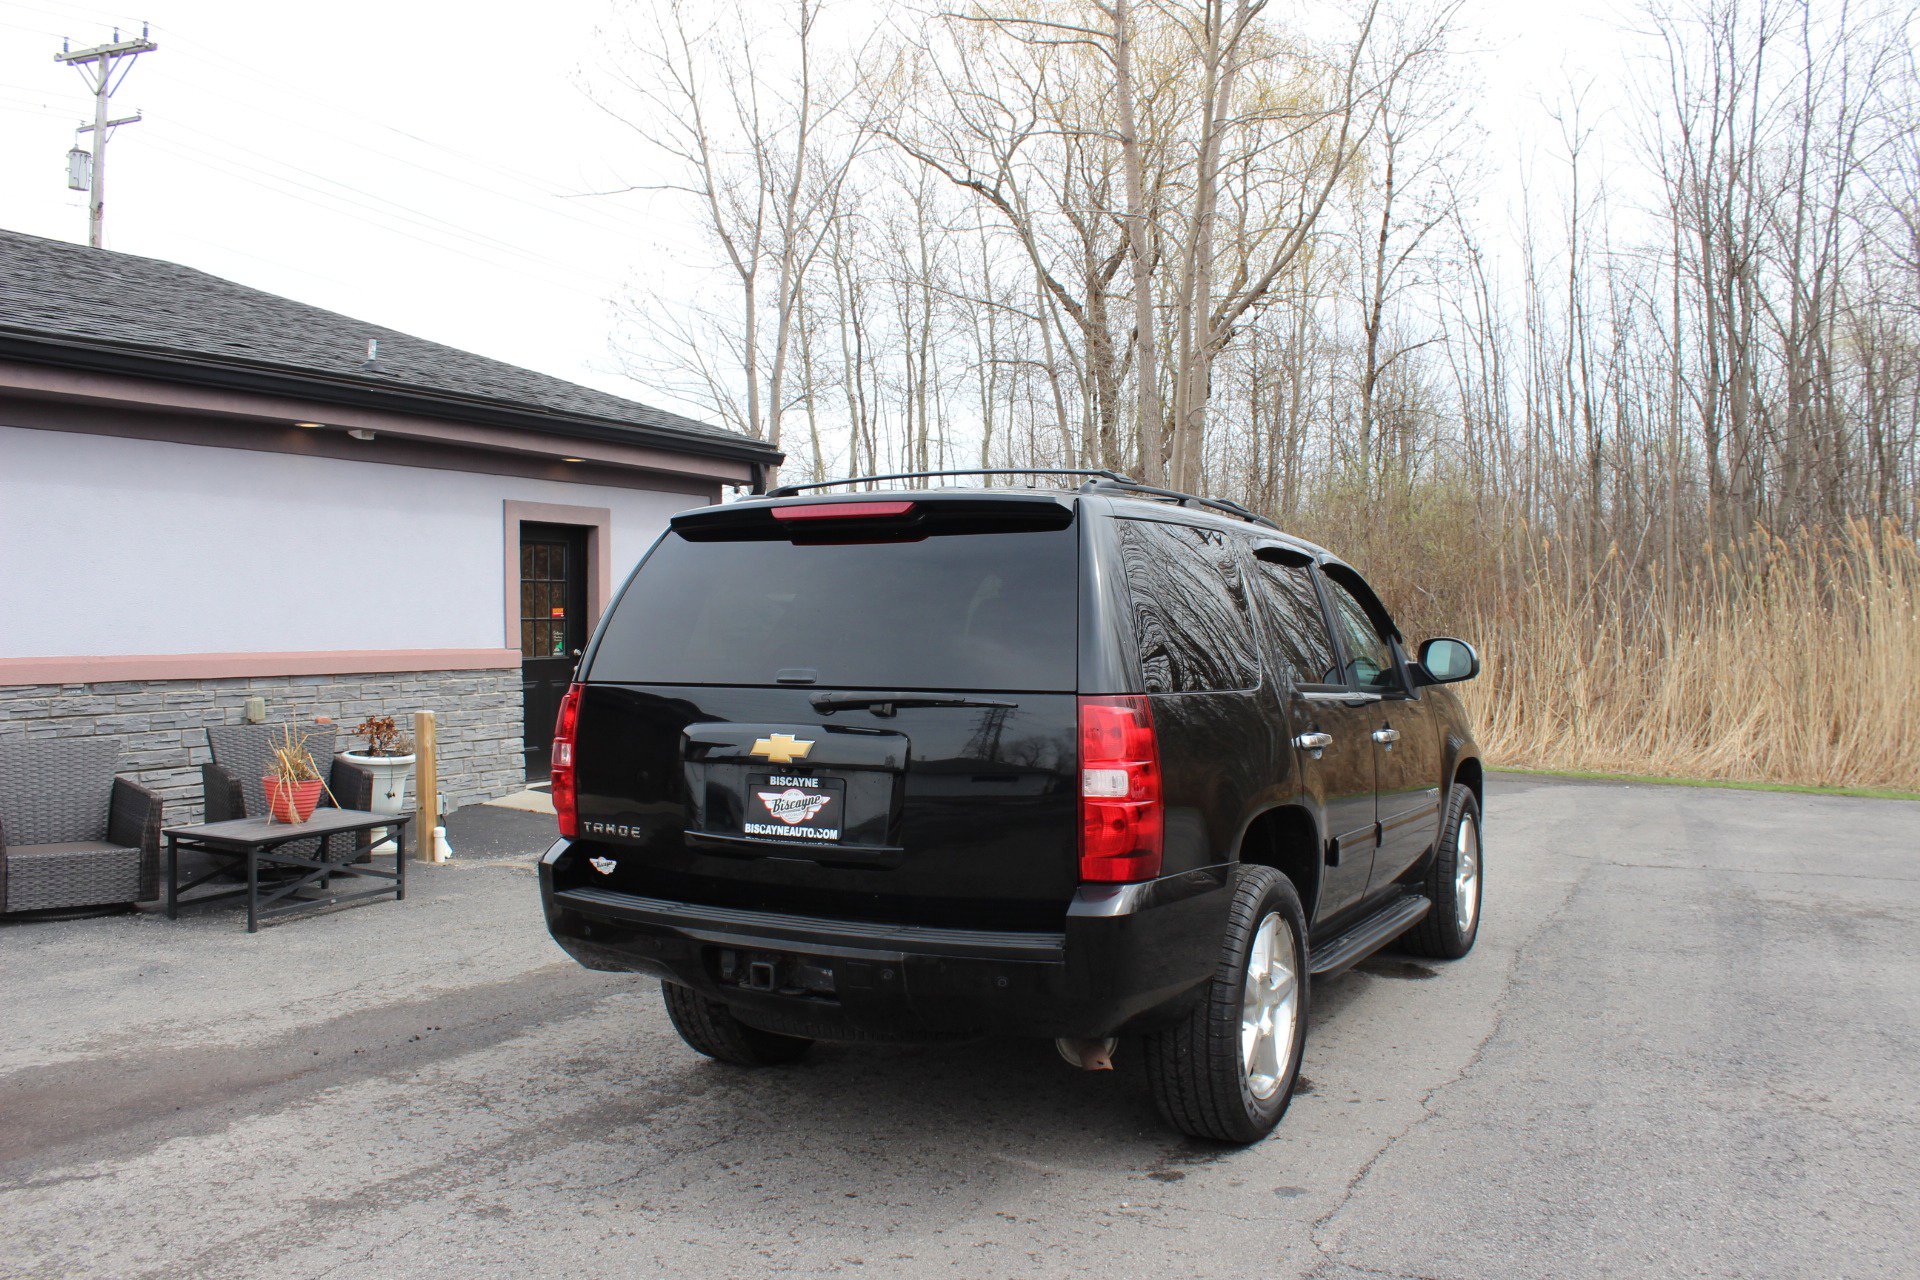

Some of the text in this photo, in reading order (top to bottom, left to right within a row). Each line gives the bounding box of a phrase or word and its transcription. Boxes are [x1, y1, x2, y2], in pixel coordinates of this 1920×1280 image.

[769, 776, 819, 788] BISCAYNE
[773, 795, 820, 813] Biscayne
[583, 821, 641, 838] TAHOE
[744, 823, 838, 840] BISCAYNEAUTO.COM
